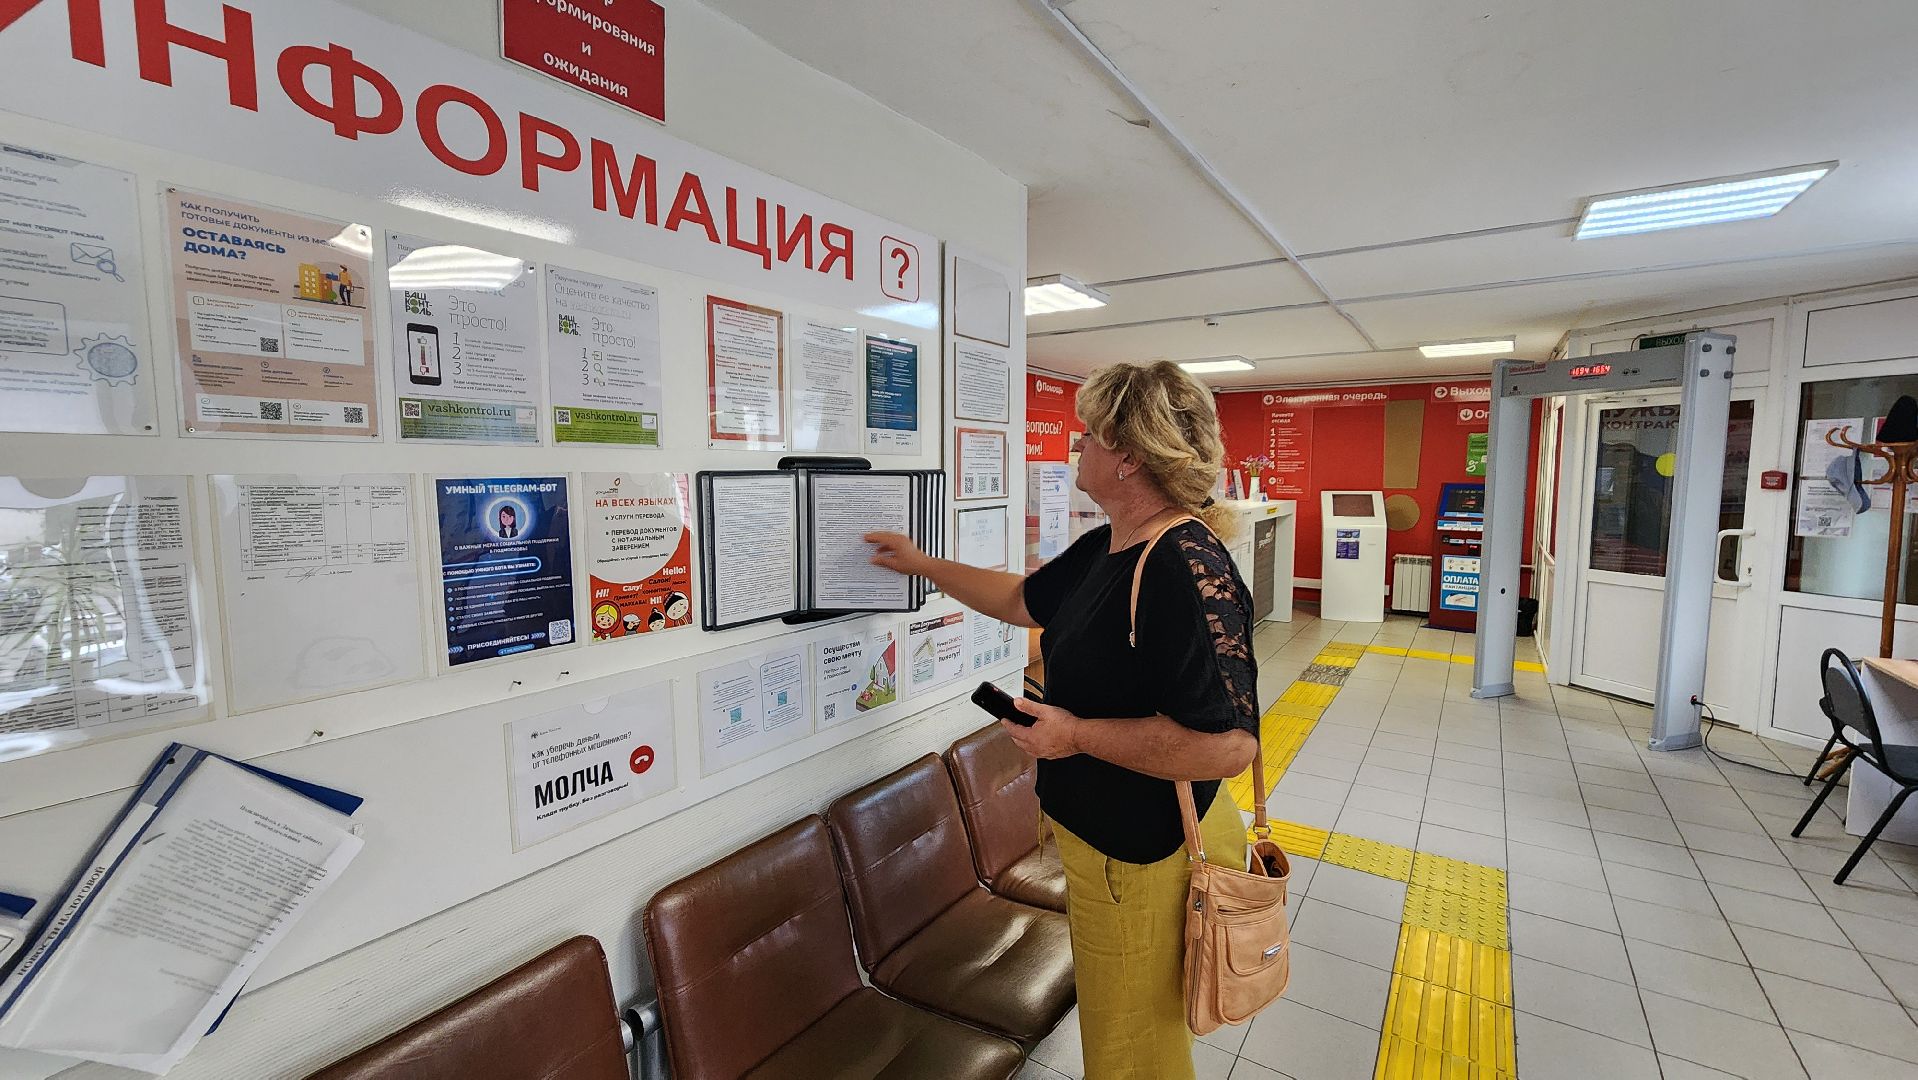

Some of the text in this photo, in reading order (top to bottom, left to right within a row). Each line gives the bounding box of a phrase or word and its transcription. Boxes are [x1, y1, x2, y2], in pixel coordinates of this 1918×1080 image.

[537, 0, 656, 57] ормирования
[581, 41, 592, 57] и
[543, 52, 629, 98] ожидания
[181, 200, 260, 224] КАК ПОЛУЧИТЬ
[181, 211, 309, 243] ГОТОВЫЕ ДОКУМЕНТЫ ИЗ
[182, 227, 287, 255] ОСТАВАЯСЬ
[183, 240, 247, 261] ДОМА?
[405, 290, 427, 301] ВАШ
[554, 282, 597, 300] Оцените
[612, 295, 651, 311] качество
[449, 295, 477, 314] Это
[449, 313, 508, 332] просто!
[592, 317, 614, 333] Это
[453, 332, 461, 346] 1
[592, 332, 636, 349] просто!
[452, 347, 461, 360] 2
[582, 348, 588, 360] 1
[453, 362, 462, 375] 3
[582, 360, 589, 372] 2
[582, 374, 590, 386] 3
[1043, 384, 1064, 395] Помощь
[1450, 386, 1491, 397] Выход
[1275, 392, 1388, 404] Электронная очередь
[428, 403, 512, 418] vashkontrol.ru
[575, 411, 639, 423] vashkontrol.ru
[1027, 420, 1064, 436] вопросы?
[1270, 428, 1276, 436] 1
[1270, 439, 1276, 448] 2
[1270, 449, 1276, 458] 3
[1269, 461, 1275, 470] 4
[445, 483, 558, 495] УМНЫЙ TELEGRAM-БОТ
[595, 499, 609, 508] НА
[612, 498, 635, 507] ВСЕХ
[611, 512, 665, 521] УСЛУГИ ПЕРЕВОДА
[611, 526, 678, 537] ПЕРЕВОД ДОКУМЕНТОВ
[617, 535, 665, 544] НОТАРИАЛЬНЫМ
[611, 543, 650, 552] ЗАВЕРЕНИЕМ
[663, 565, 687, 576] Hello!
[1443, 575, 1479, 585] ОПЛАТА
[823, 640, 861, 655] Осуществи
[823, 650, 863, 665] свою мечту
[532, 731, 632, 770] от телефонных мошенников?
[546, 742, 575, 756] уберечь
[534, 760, 614, 810] МОЛЧА
[536, 809, 558, 821] Клади
[559, 802, 582, 814] трубку.
[582, 796, 593, 804] Без
[57, 866, 106, 927] НАЛОГОВОЙ
